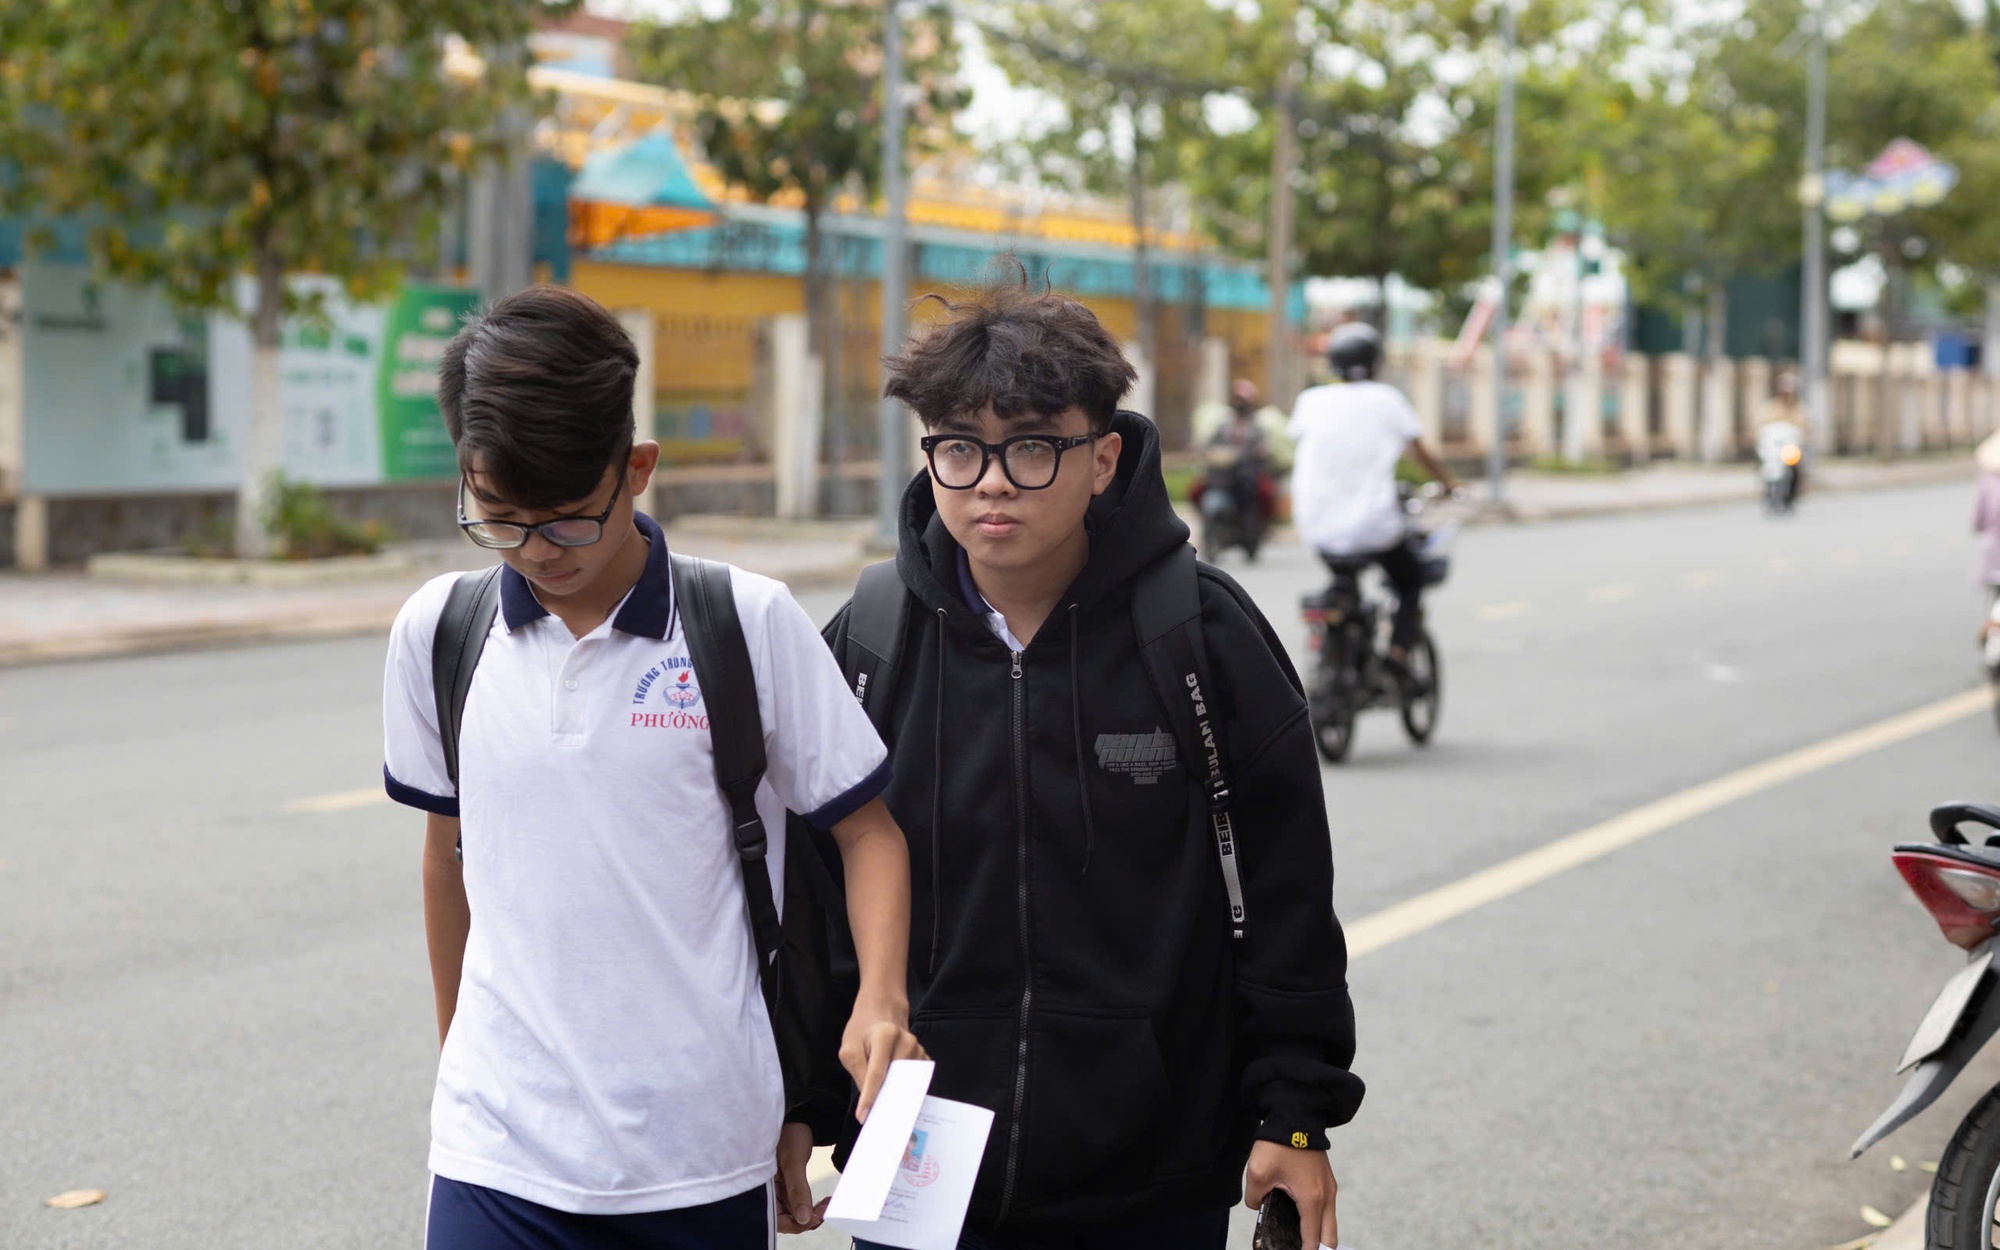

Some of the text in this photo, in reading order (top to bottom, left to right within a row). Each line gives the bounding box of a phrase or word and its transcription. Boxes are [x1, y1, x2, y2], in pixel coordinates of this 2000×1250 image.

[660, 657, 692, 671] TRUNG
[1186, 672, 1207, 717] BAG
[630, 711, 710, 730] PHƯỜNG
